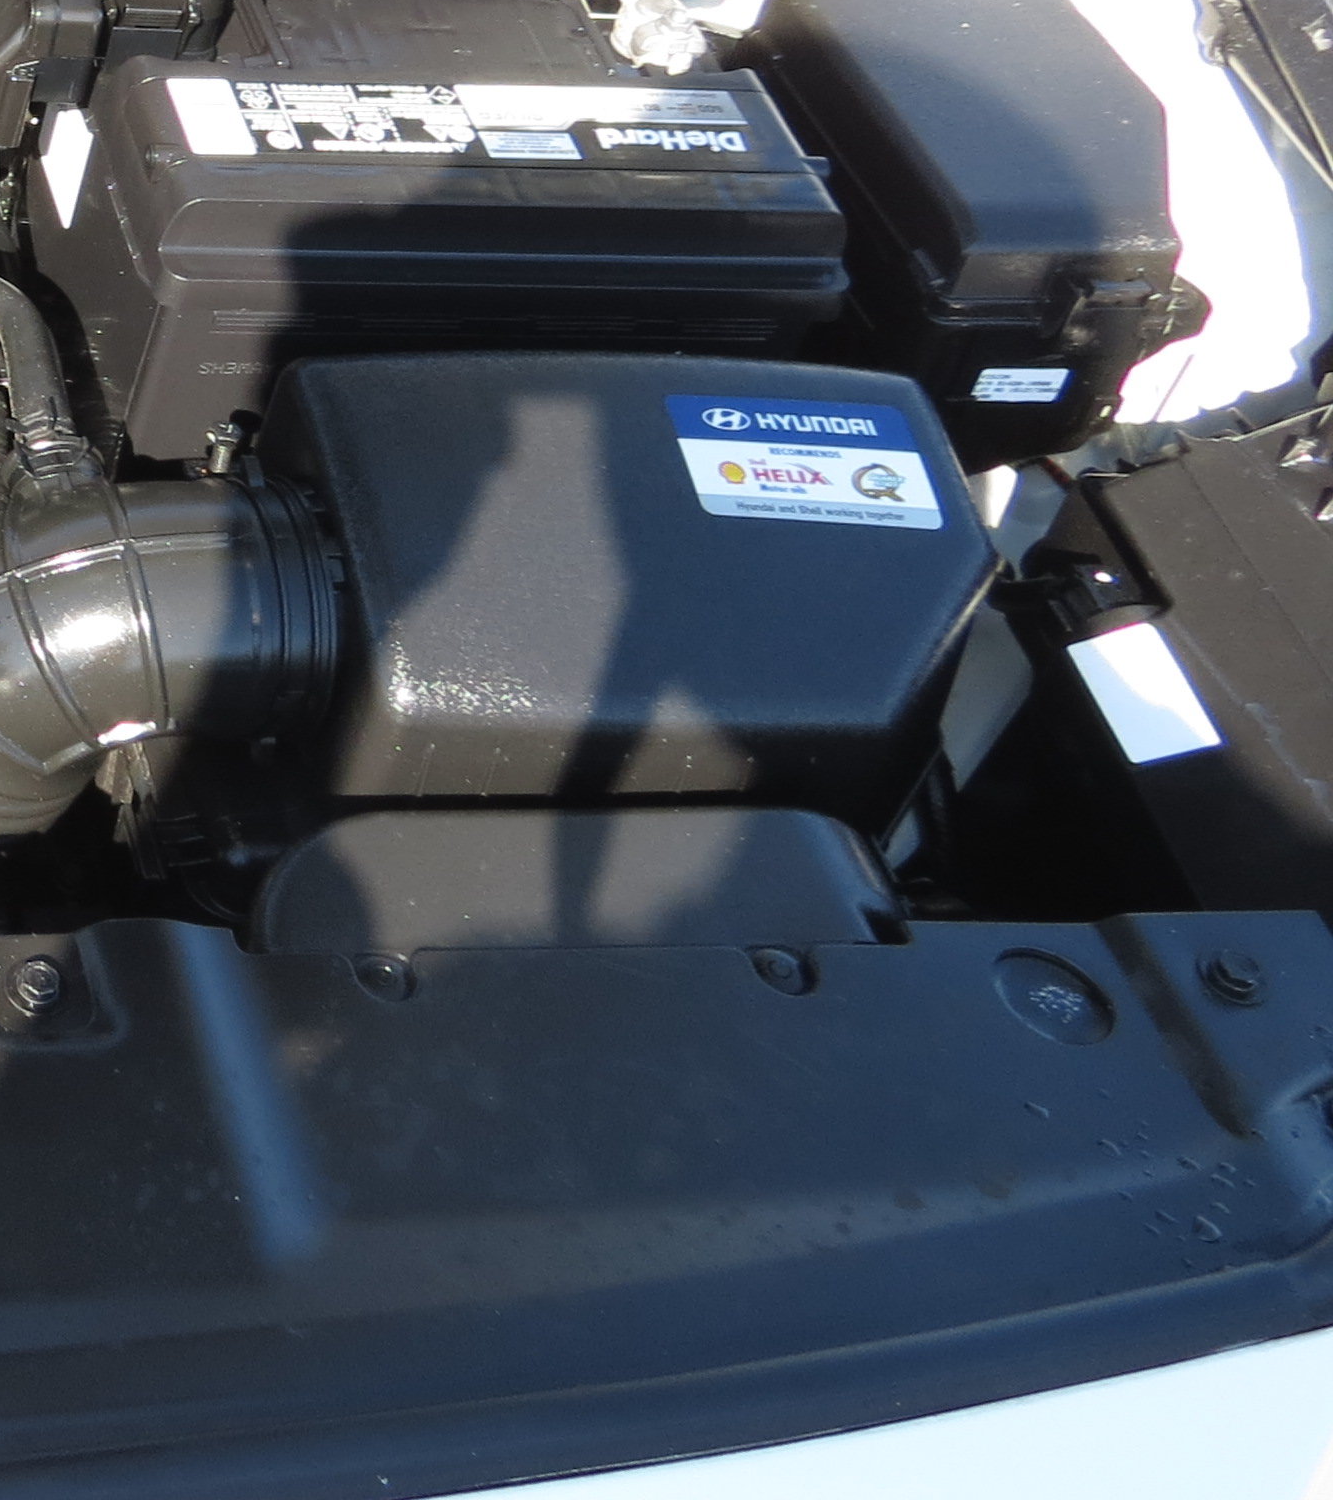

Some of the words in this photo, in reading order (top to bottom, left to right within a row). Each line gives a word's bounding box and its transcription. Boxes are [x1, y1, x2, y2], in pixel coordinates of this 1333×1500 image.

[594, 127, 749, 153] DieHard
[754, 411, 878, 436] HYUNDAI
[768, 446, 842, 459] RECOMMENDS
[750, 464, 831, 486] HELIX
[736, 501, 777, 514] Hyundai
[778, 503, 796, 514] and
[798, 504, 823, 516] Shell
[824, 507, 865, 520] working
[865, 509, 906, 522] together
